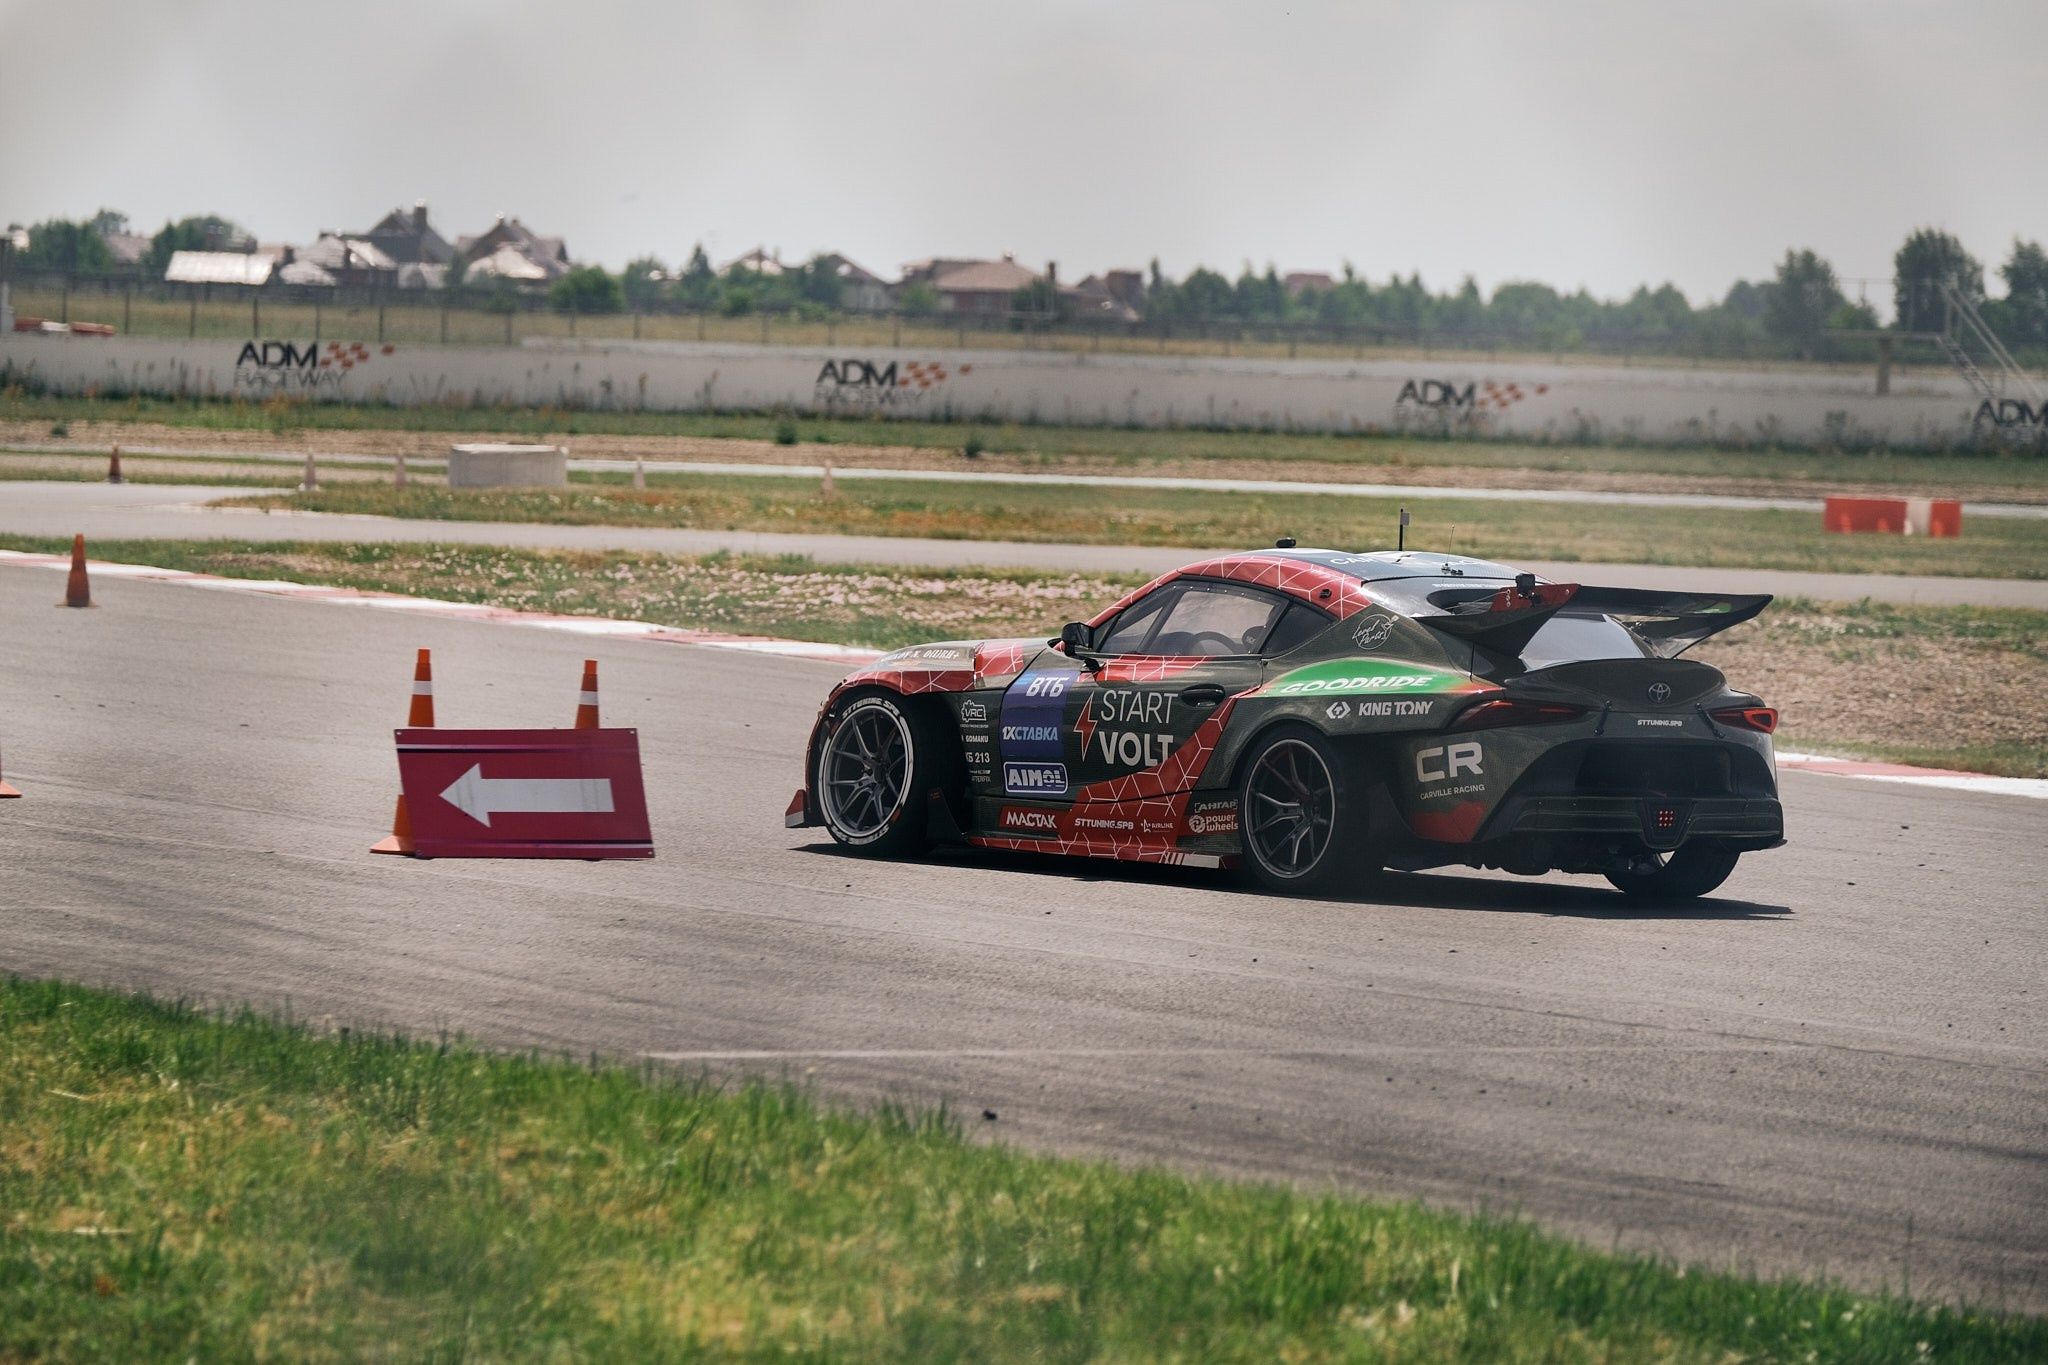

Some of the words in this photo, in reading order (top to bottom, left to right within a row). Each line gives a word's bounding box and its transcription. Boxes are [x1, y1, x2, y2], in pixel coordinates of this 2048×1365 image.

[236, 340, 318, 368] ADM
[816, 359, 897, 387] ADM
[1396, 379, 1475, 407] ADM
[1025, 676, 1070, 698] ВТБ
[1280, 676, 1433, 693] GOODRIDE
[1100, 689, 1178, 724] START
[1358, 702, 1391, 716] KING
[1394, 700, 1434, 716] TONY
[974, 751, 990, 763] 213
[1098, 730, 1174, 767] VOLT
[1416, 742, 1483, 782] CR
[1008, 768, 1065, 788] AIMOL
[1420, 787, 1452, 800] CARVILLE
[1453, 784, 1485, 795] RACING
[1074, 817, 1134, 830] STTUNING.SPB
[1205, 814, 1236, 825] power
[1206, 821, 1239, 832] wheels
